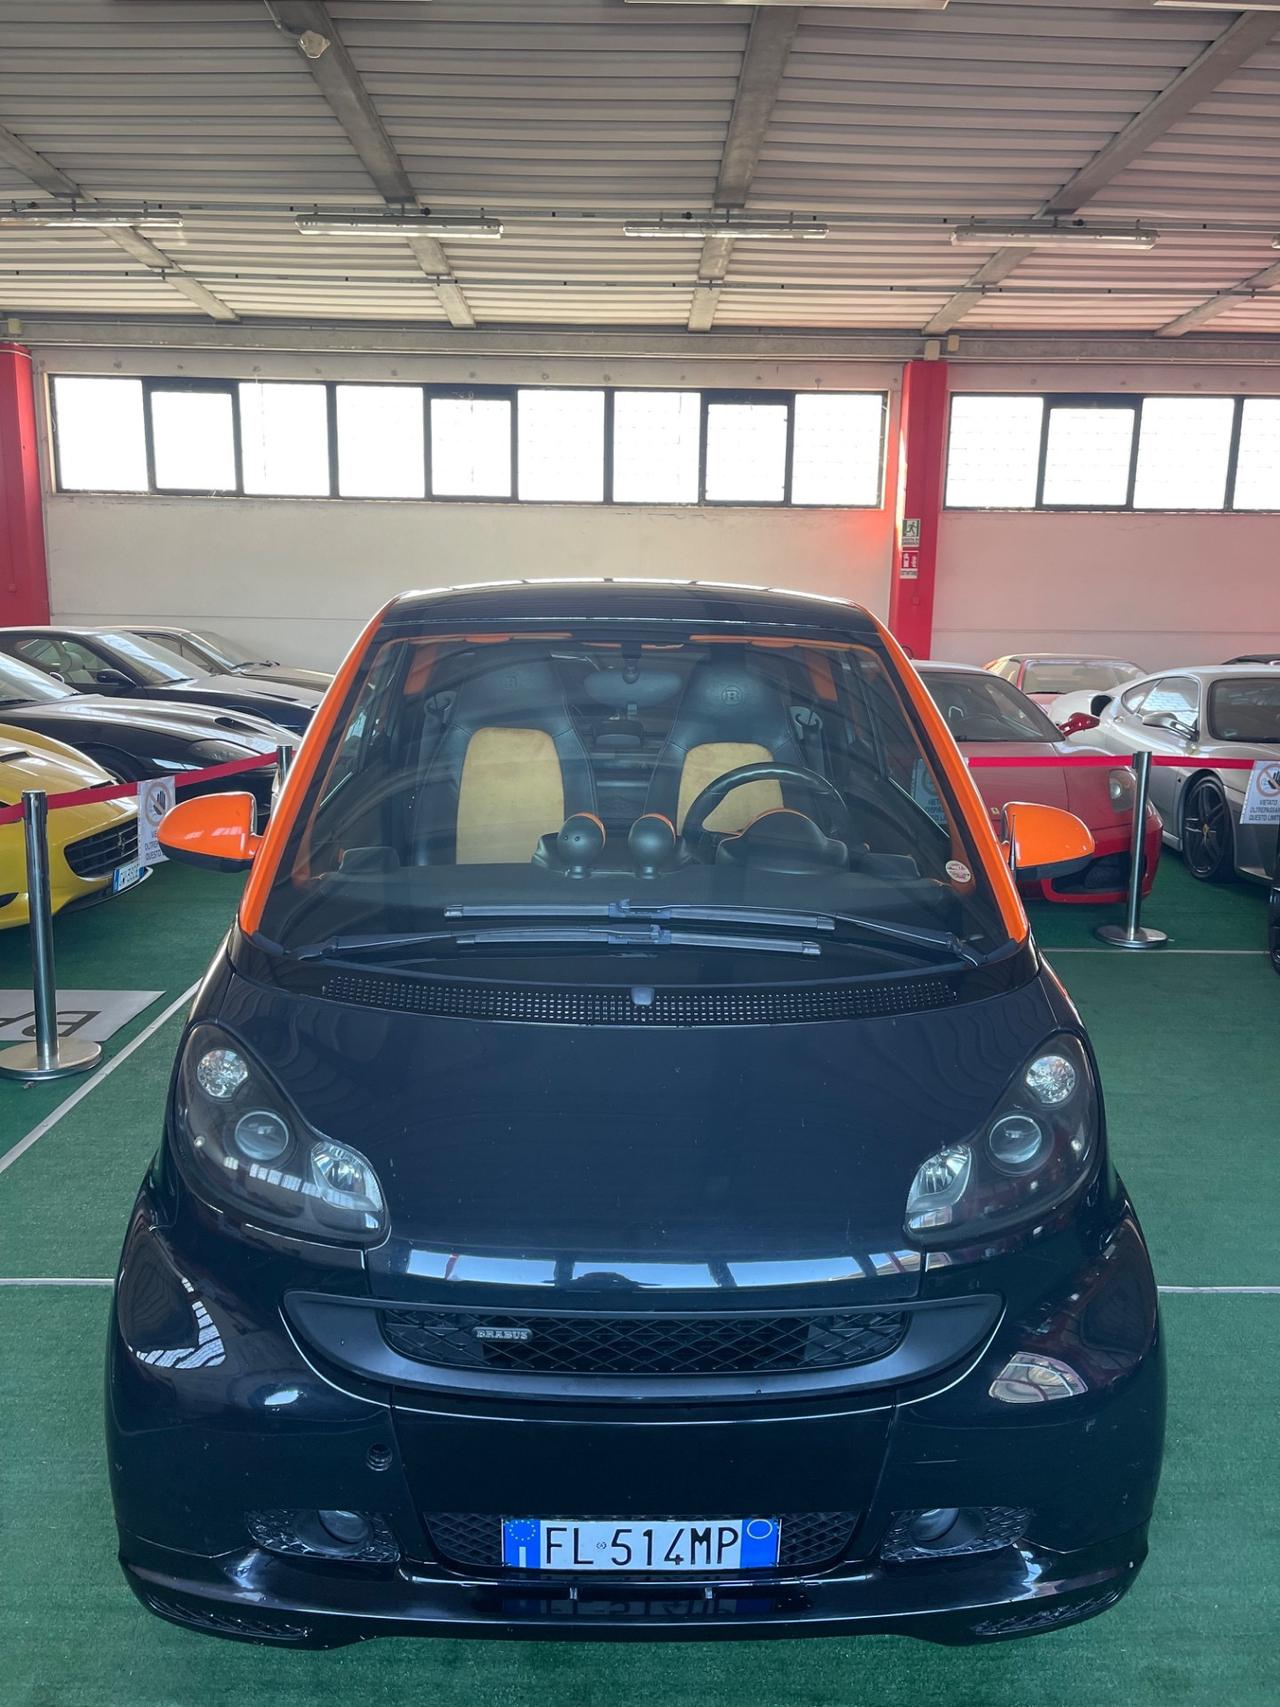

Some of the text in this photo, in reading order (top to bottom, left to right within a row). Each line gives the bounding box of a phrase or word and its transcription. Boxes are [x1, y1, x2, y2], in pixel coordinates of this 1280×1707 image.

[476, 1330, 528, 1340] BRABUS
[545, 1527, 594, 1565] FL
[610, 1527, 739, 1567] 514MP
